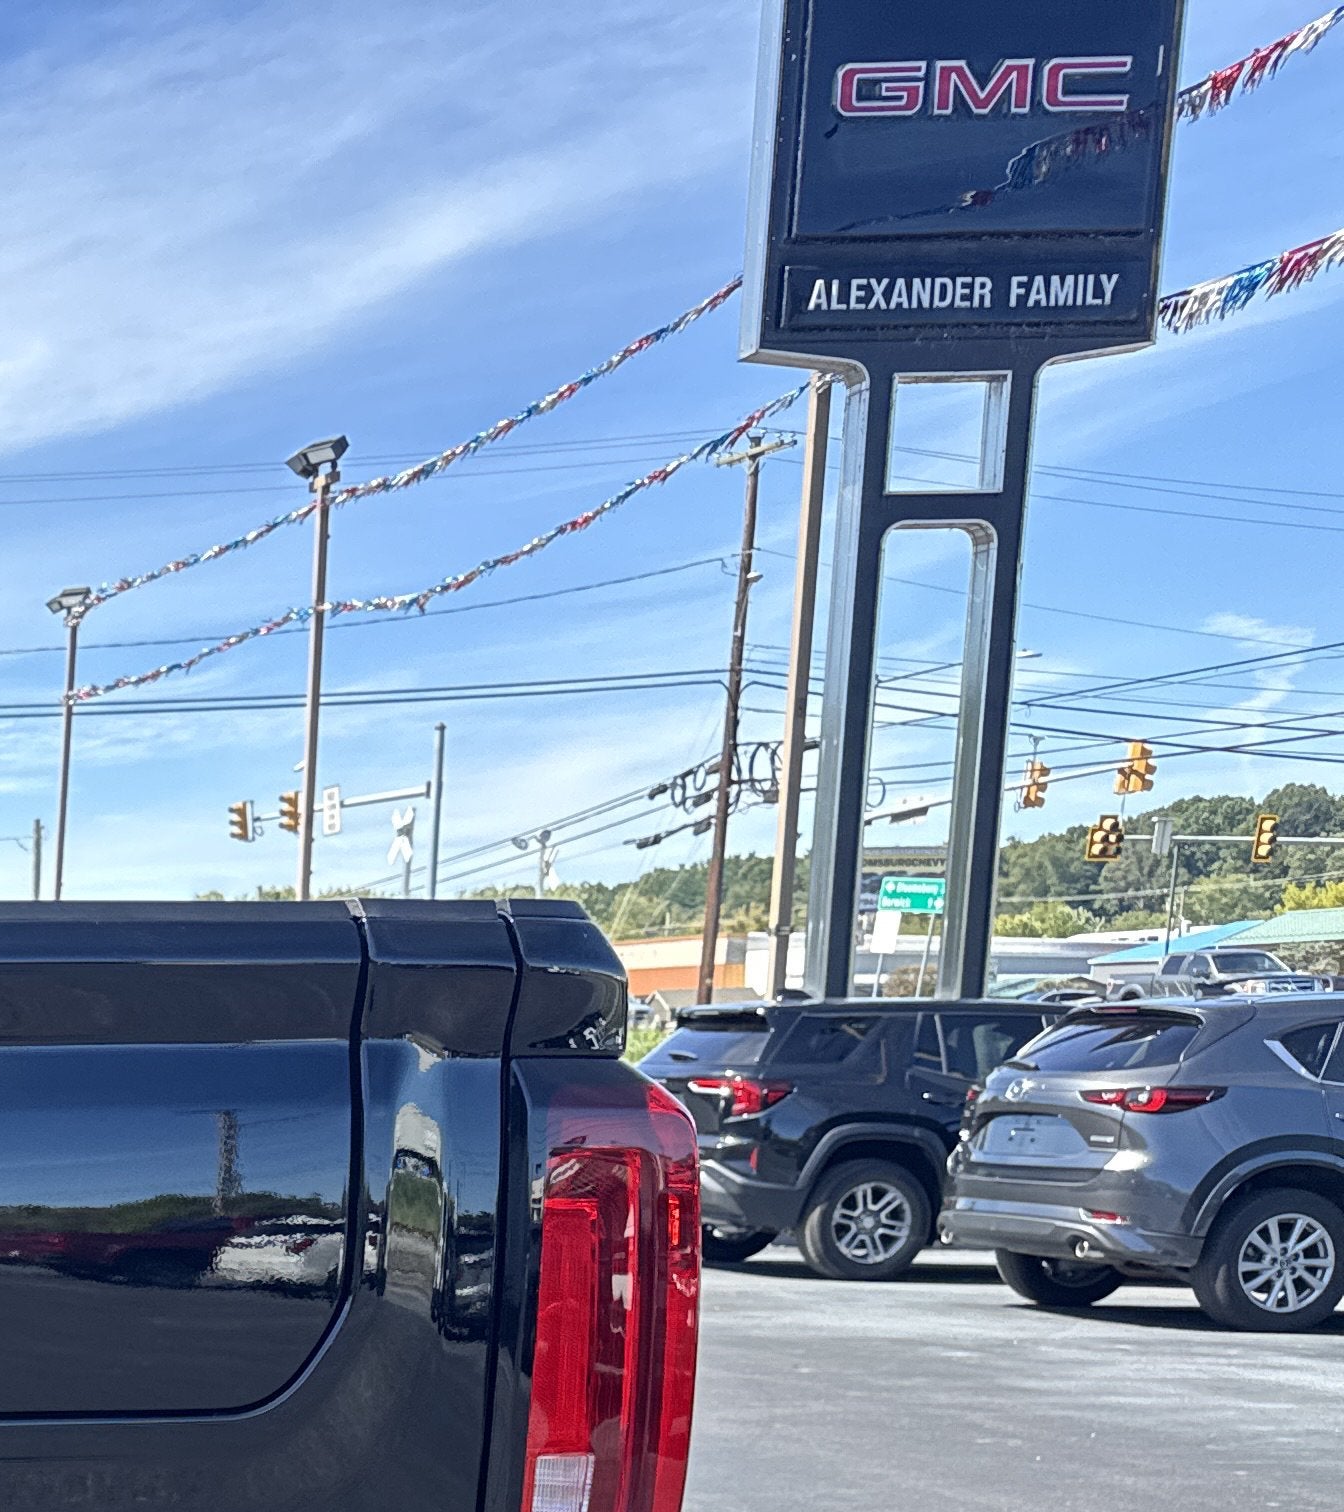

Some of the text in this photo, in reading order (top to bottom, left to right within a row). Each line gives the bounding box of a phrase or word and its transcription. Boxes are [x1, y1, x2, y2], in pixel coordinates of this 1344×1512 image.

[834, 55, 1134, 118] GMC
[807, 273, 1120, 312] ALEXANDER FAMILY
